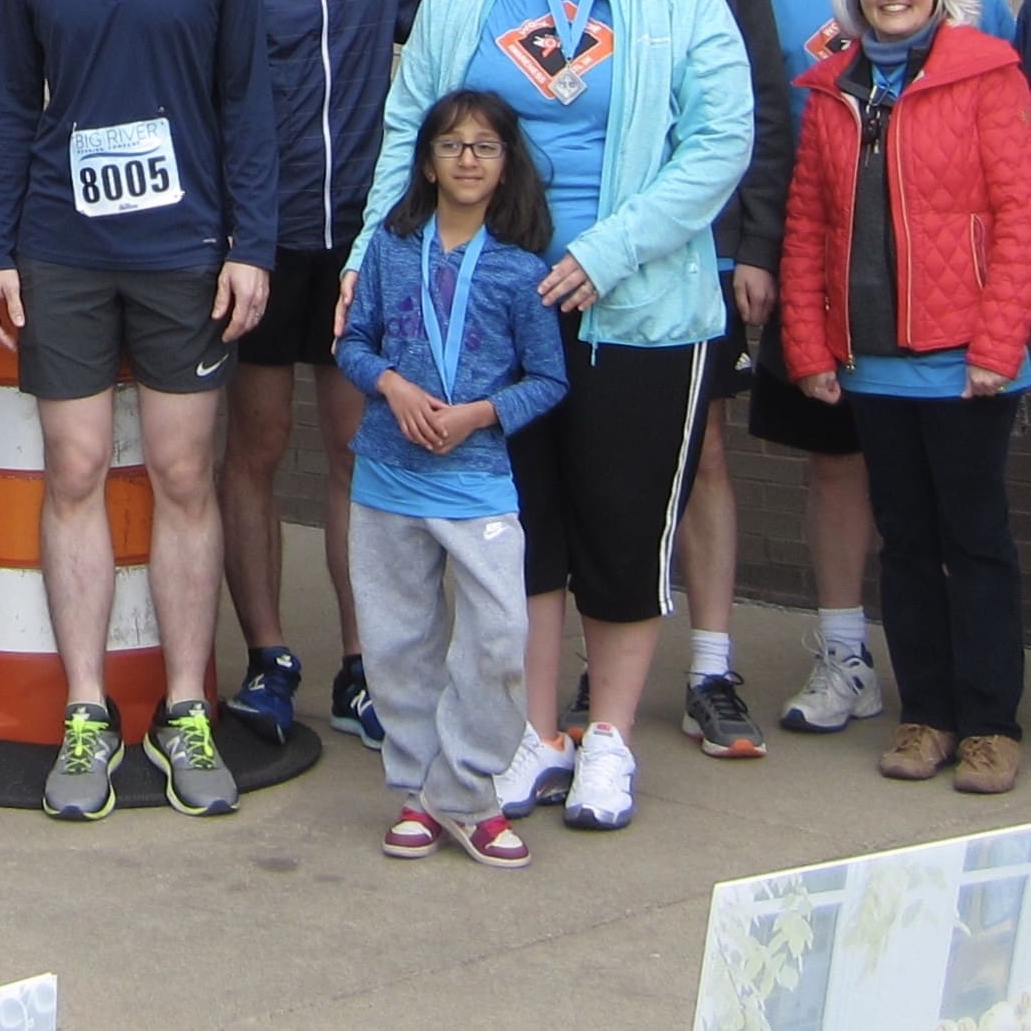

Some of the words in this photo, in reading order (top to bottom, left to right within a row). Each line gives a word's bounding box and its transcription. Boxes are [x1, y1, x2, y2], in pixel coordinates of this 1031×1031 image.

[75, 131, 102, 150] BIG
[105, 122, 158, 145] RIVER
[79, 155, 170, 204] 8005
